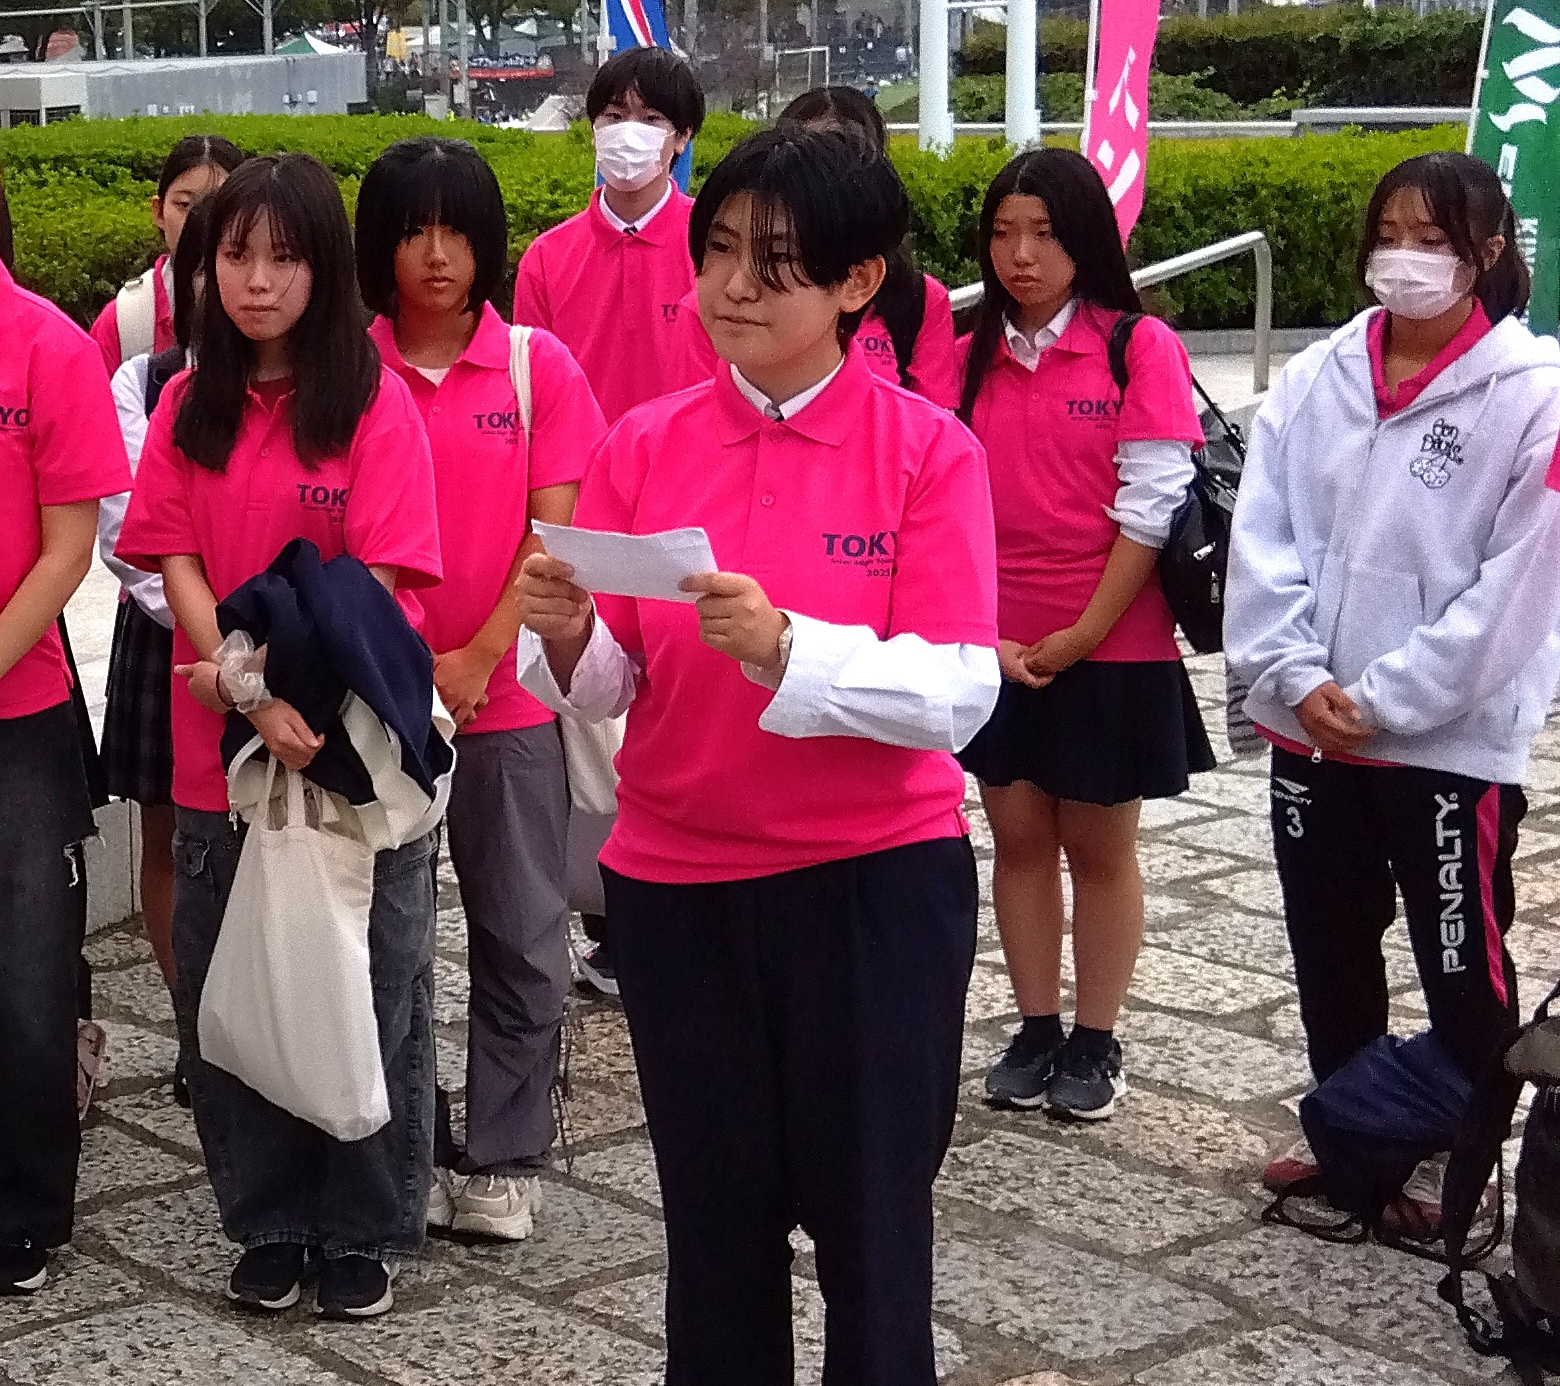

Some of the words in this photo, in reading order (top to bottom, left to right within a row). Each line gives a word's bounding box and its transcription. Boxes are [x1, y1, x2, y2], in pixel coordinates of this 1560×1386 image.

[1065, 399, 1122, 416] TOKY
[472, 412, 515, 429] TOK
[297, 484, 347, 507] TOK
[1434, 793, 1477, 975] PENALTY
